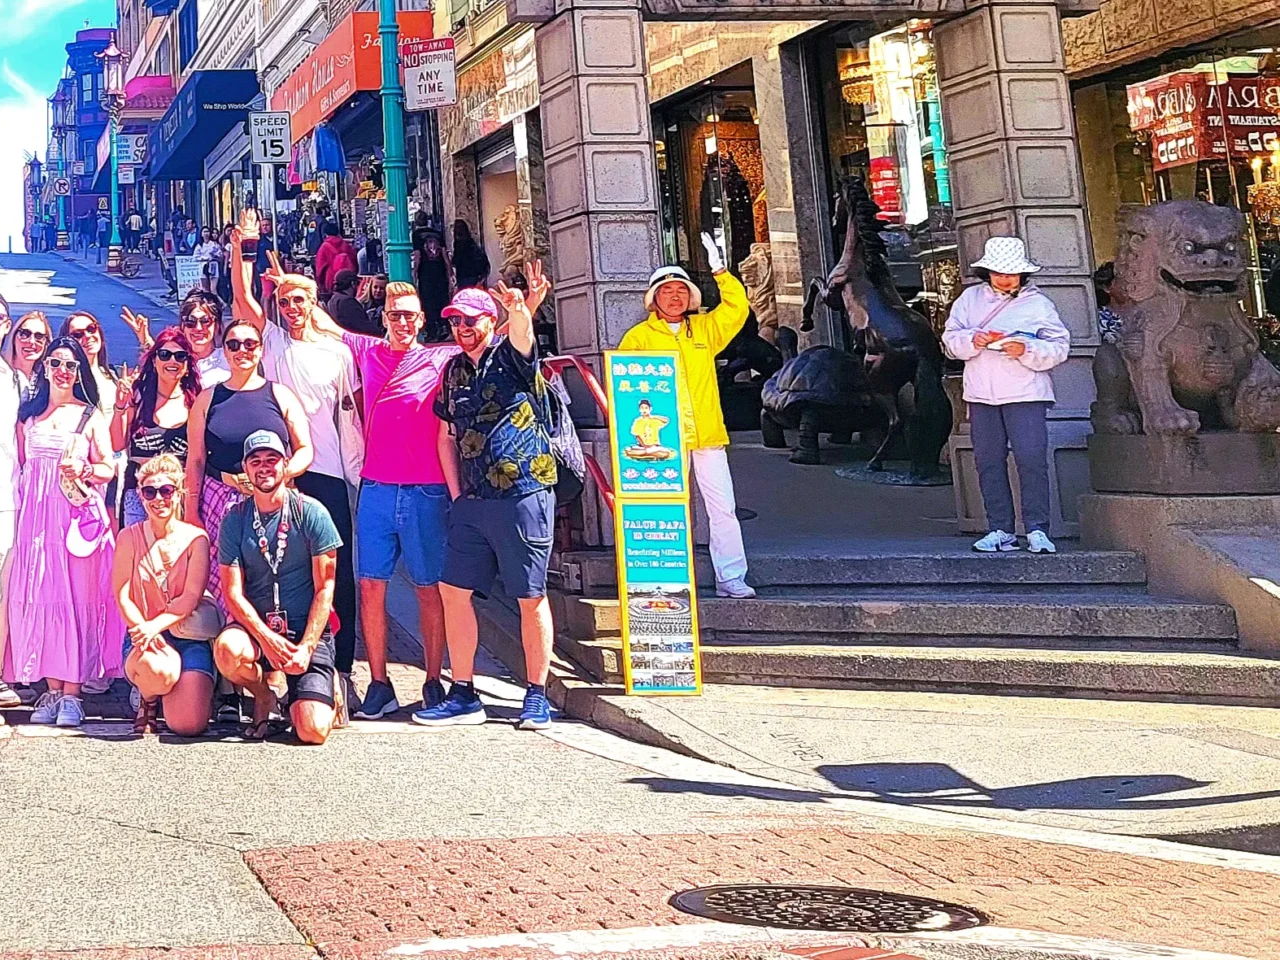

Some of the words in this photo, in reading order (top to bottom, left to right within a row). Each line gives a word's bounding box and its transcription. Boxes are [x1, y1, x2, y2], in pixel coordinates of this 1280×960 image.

[410, 41, 447, 53] TOW-AWAY
[404, 53, 419, 68] NO
[420, 52, 453, 65] STOPPING
[419, 70, 441, 82] ANY
[417, 82, 444, 94] TIME
[253, 117, 288, 126] SPEED
[257, 127, 284, 136] LIMIT
[261, 139, 285, 158] 15
[624, 520, 657, 530] FALUN
[659, 520, 686, 530] DAFA
